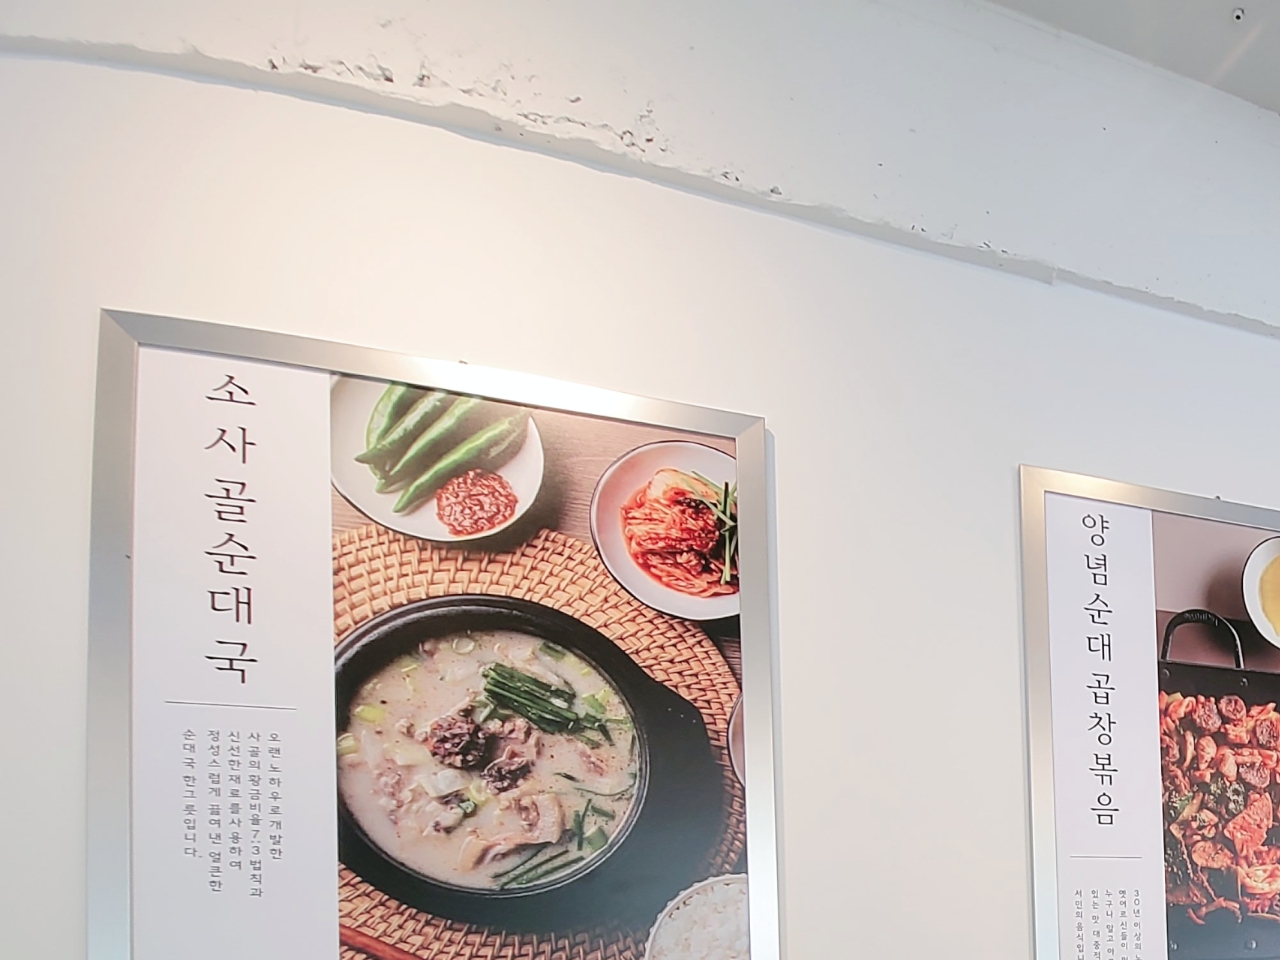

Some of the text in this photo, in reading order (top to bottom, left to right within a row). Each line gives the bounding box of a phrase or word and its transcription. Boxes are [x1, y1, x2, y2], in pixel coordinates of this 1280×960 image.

[204, 375, 258, 684] 소사골순대국
[1082, 514, 1119, 825] 양념순대곱창볶음
[182, 729, 196, 769] 순대국
[207, 730, 221, 797] 정성스럽게
[208, 852, 223, 892] 얼큰한
[1091, 890, 1100, 909] 있는
[1105, 890, 1114, 918] 누구나
[1133, 890, 1141, 917] 30년
[1092, 915, 1100, 924] 맛
[1106, 925, 1115, 942] 알고
[1134, 922, 1142, 950] 이상의
